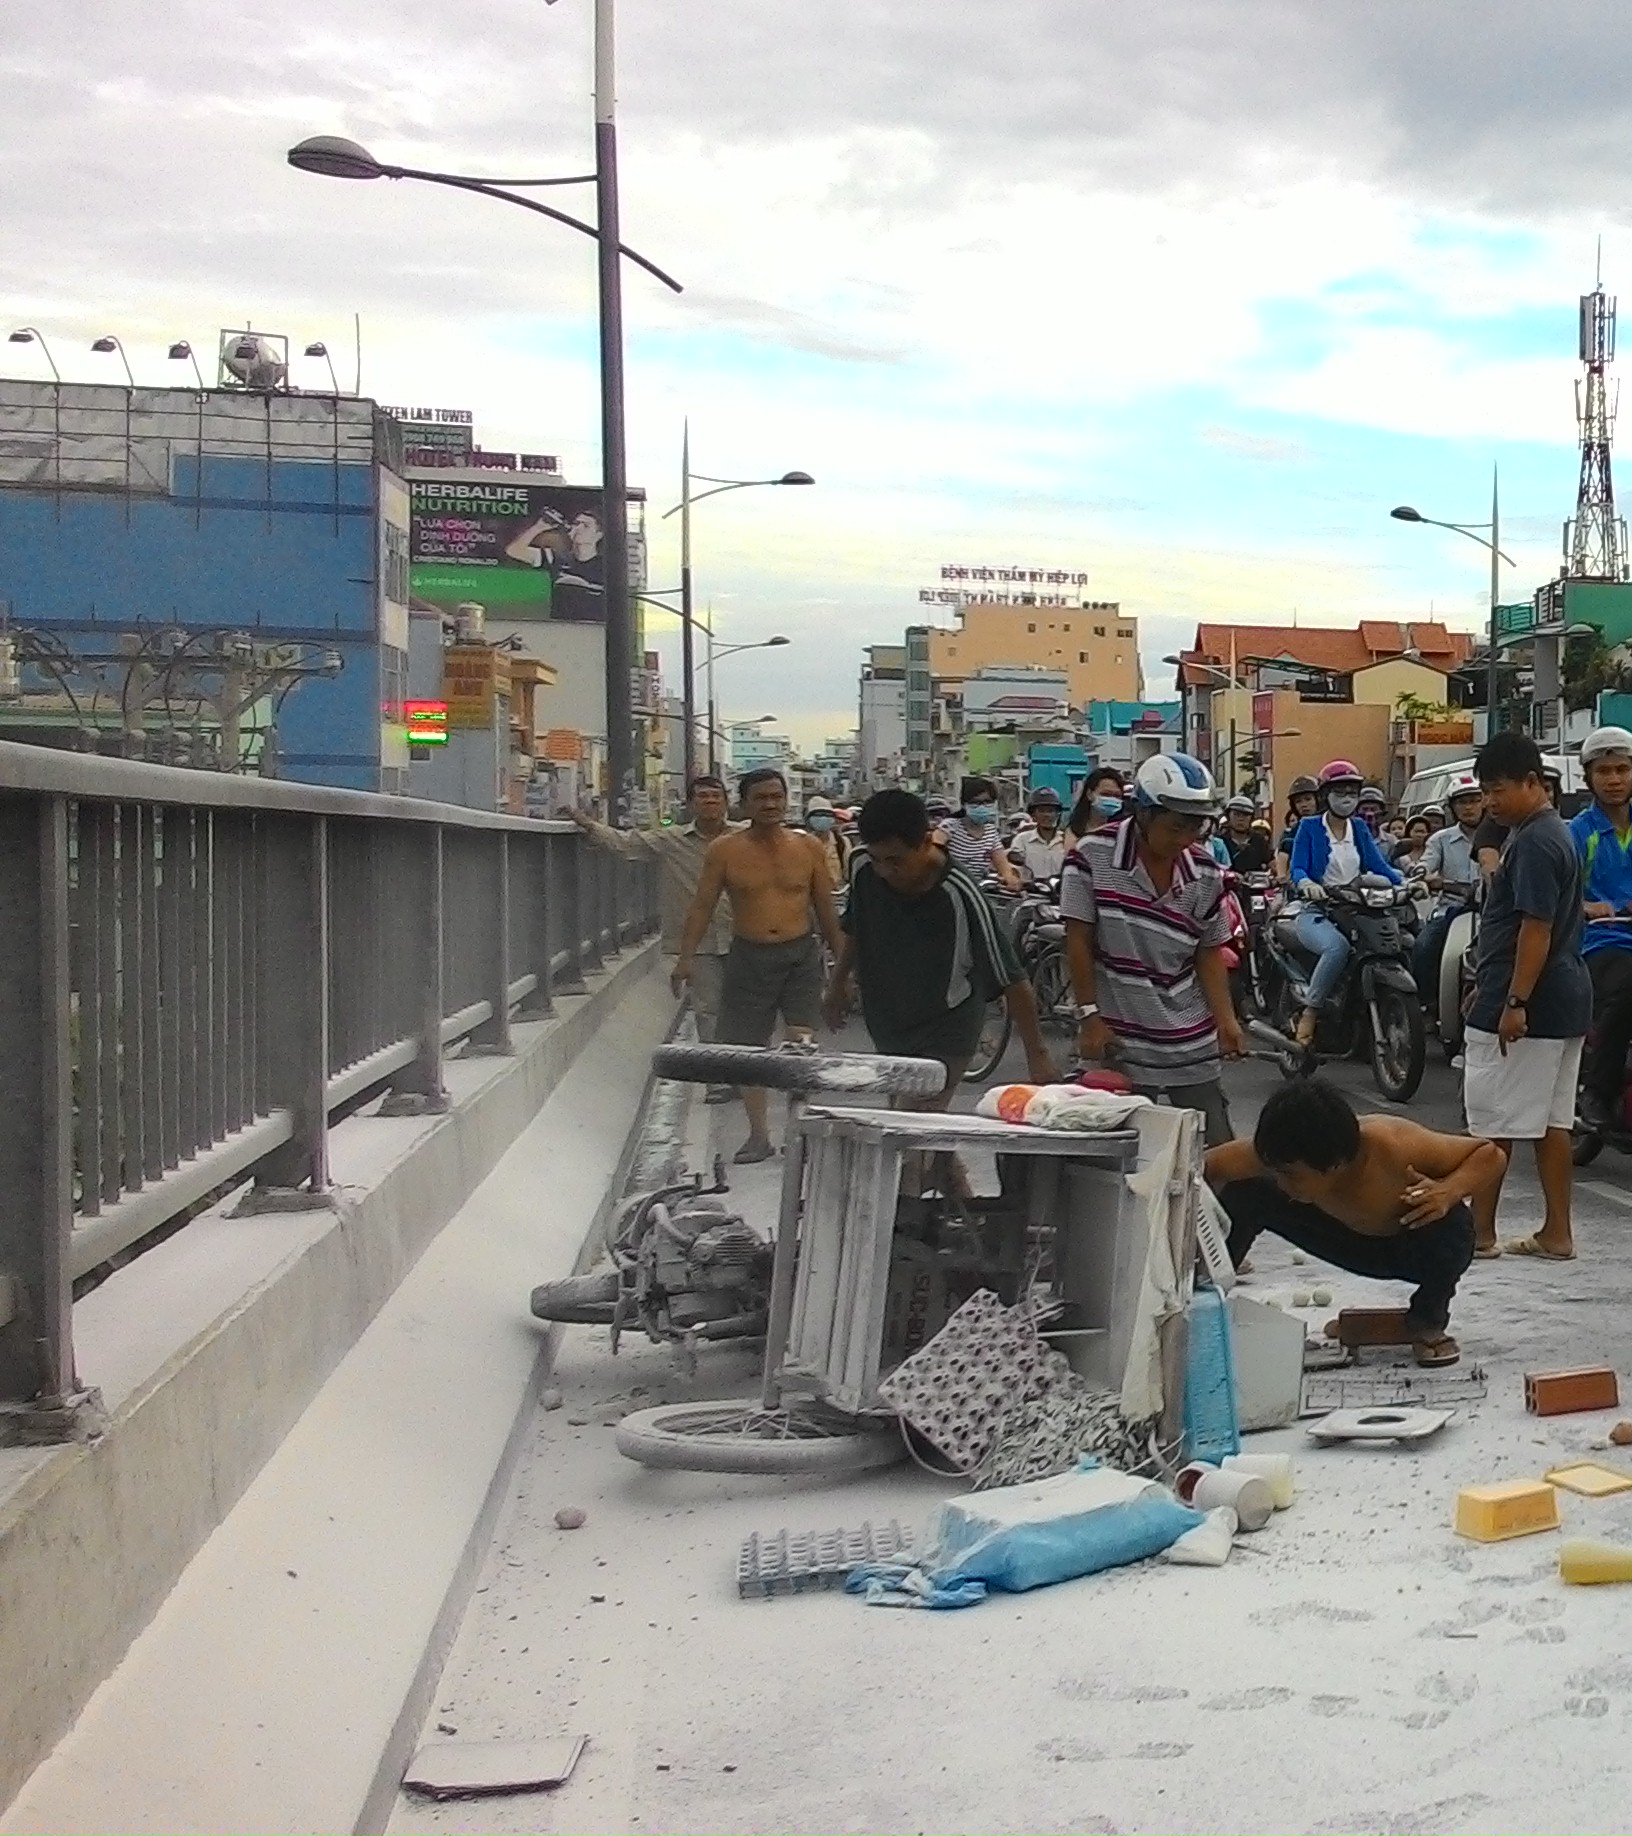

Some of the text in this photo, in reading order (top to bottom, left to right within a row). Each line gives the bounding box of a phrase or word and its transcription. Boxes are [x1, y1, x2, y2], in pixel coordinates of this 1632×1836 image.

[434, 408, 472, 424] TOWER
[411, 483, 529, 501] HERBALIFE
[411, 497, 529, 515] NUTRITION
